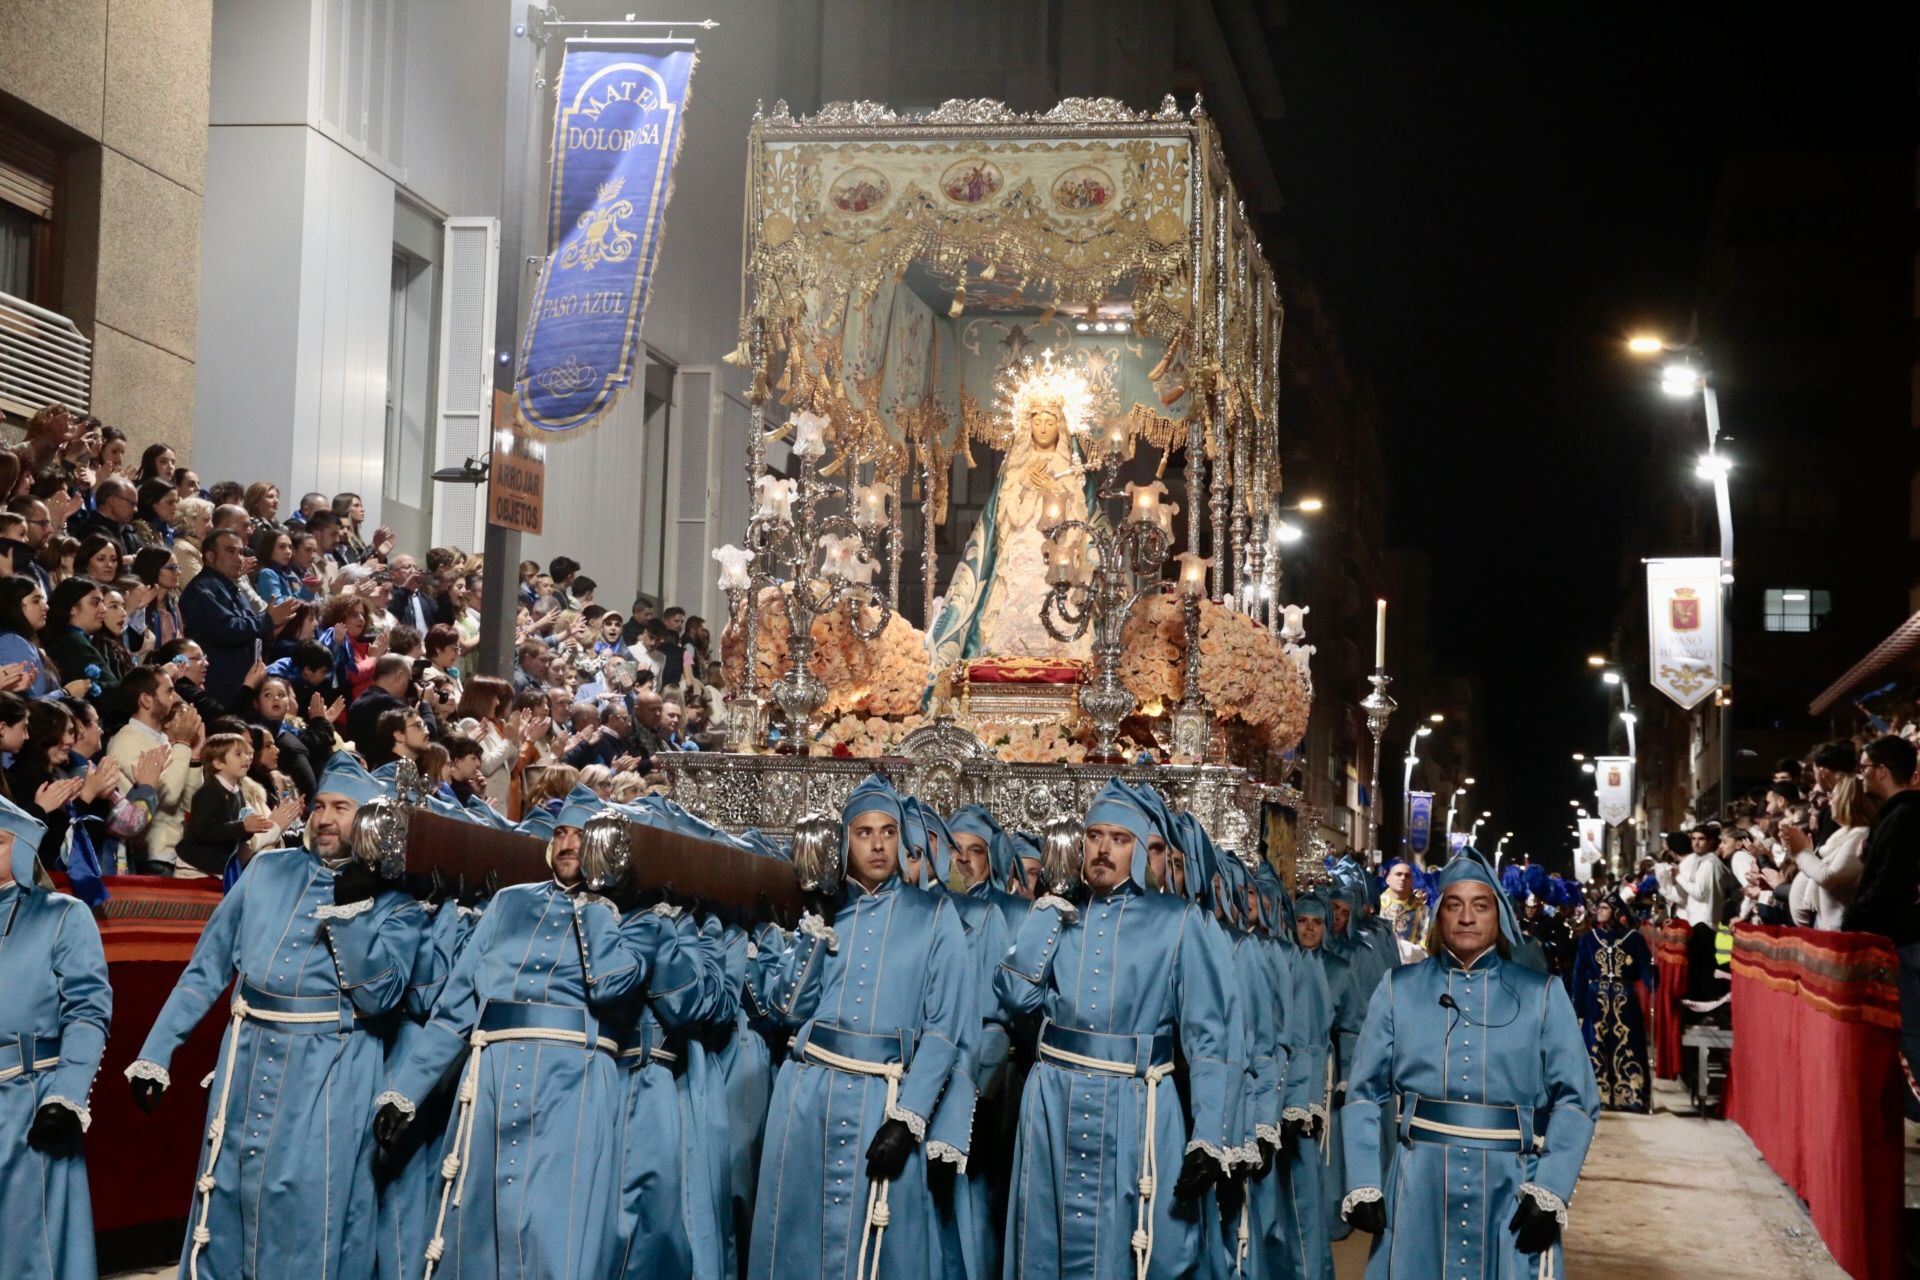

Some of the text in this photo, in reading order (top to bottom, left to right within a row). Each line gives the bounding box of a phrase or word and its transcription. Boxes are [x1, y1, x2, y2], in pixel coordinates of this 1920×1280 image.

[543, 291, 625, 319] PASO AZUL
[496, 463, 541, 496] ARROJAR
[496, 496, 538, 530] OBJETOS
